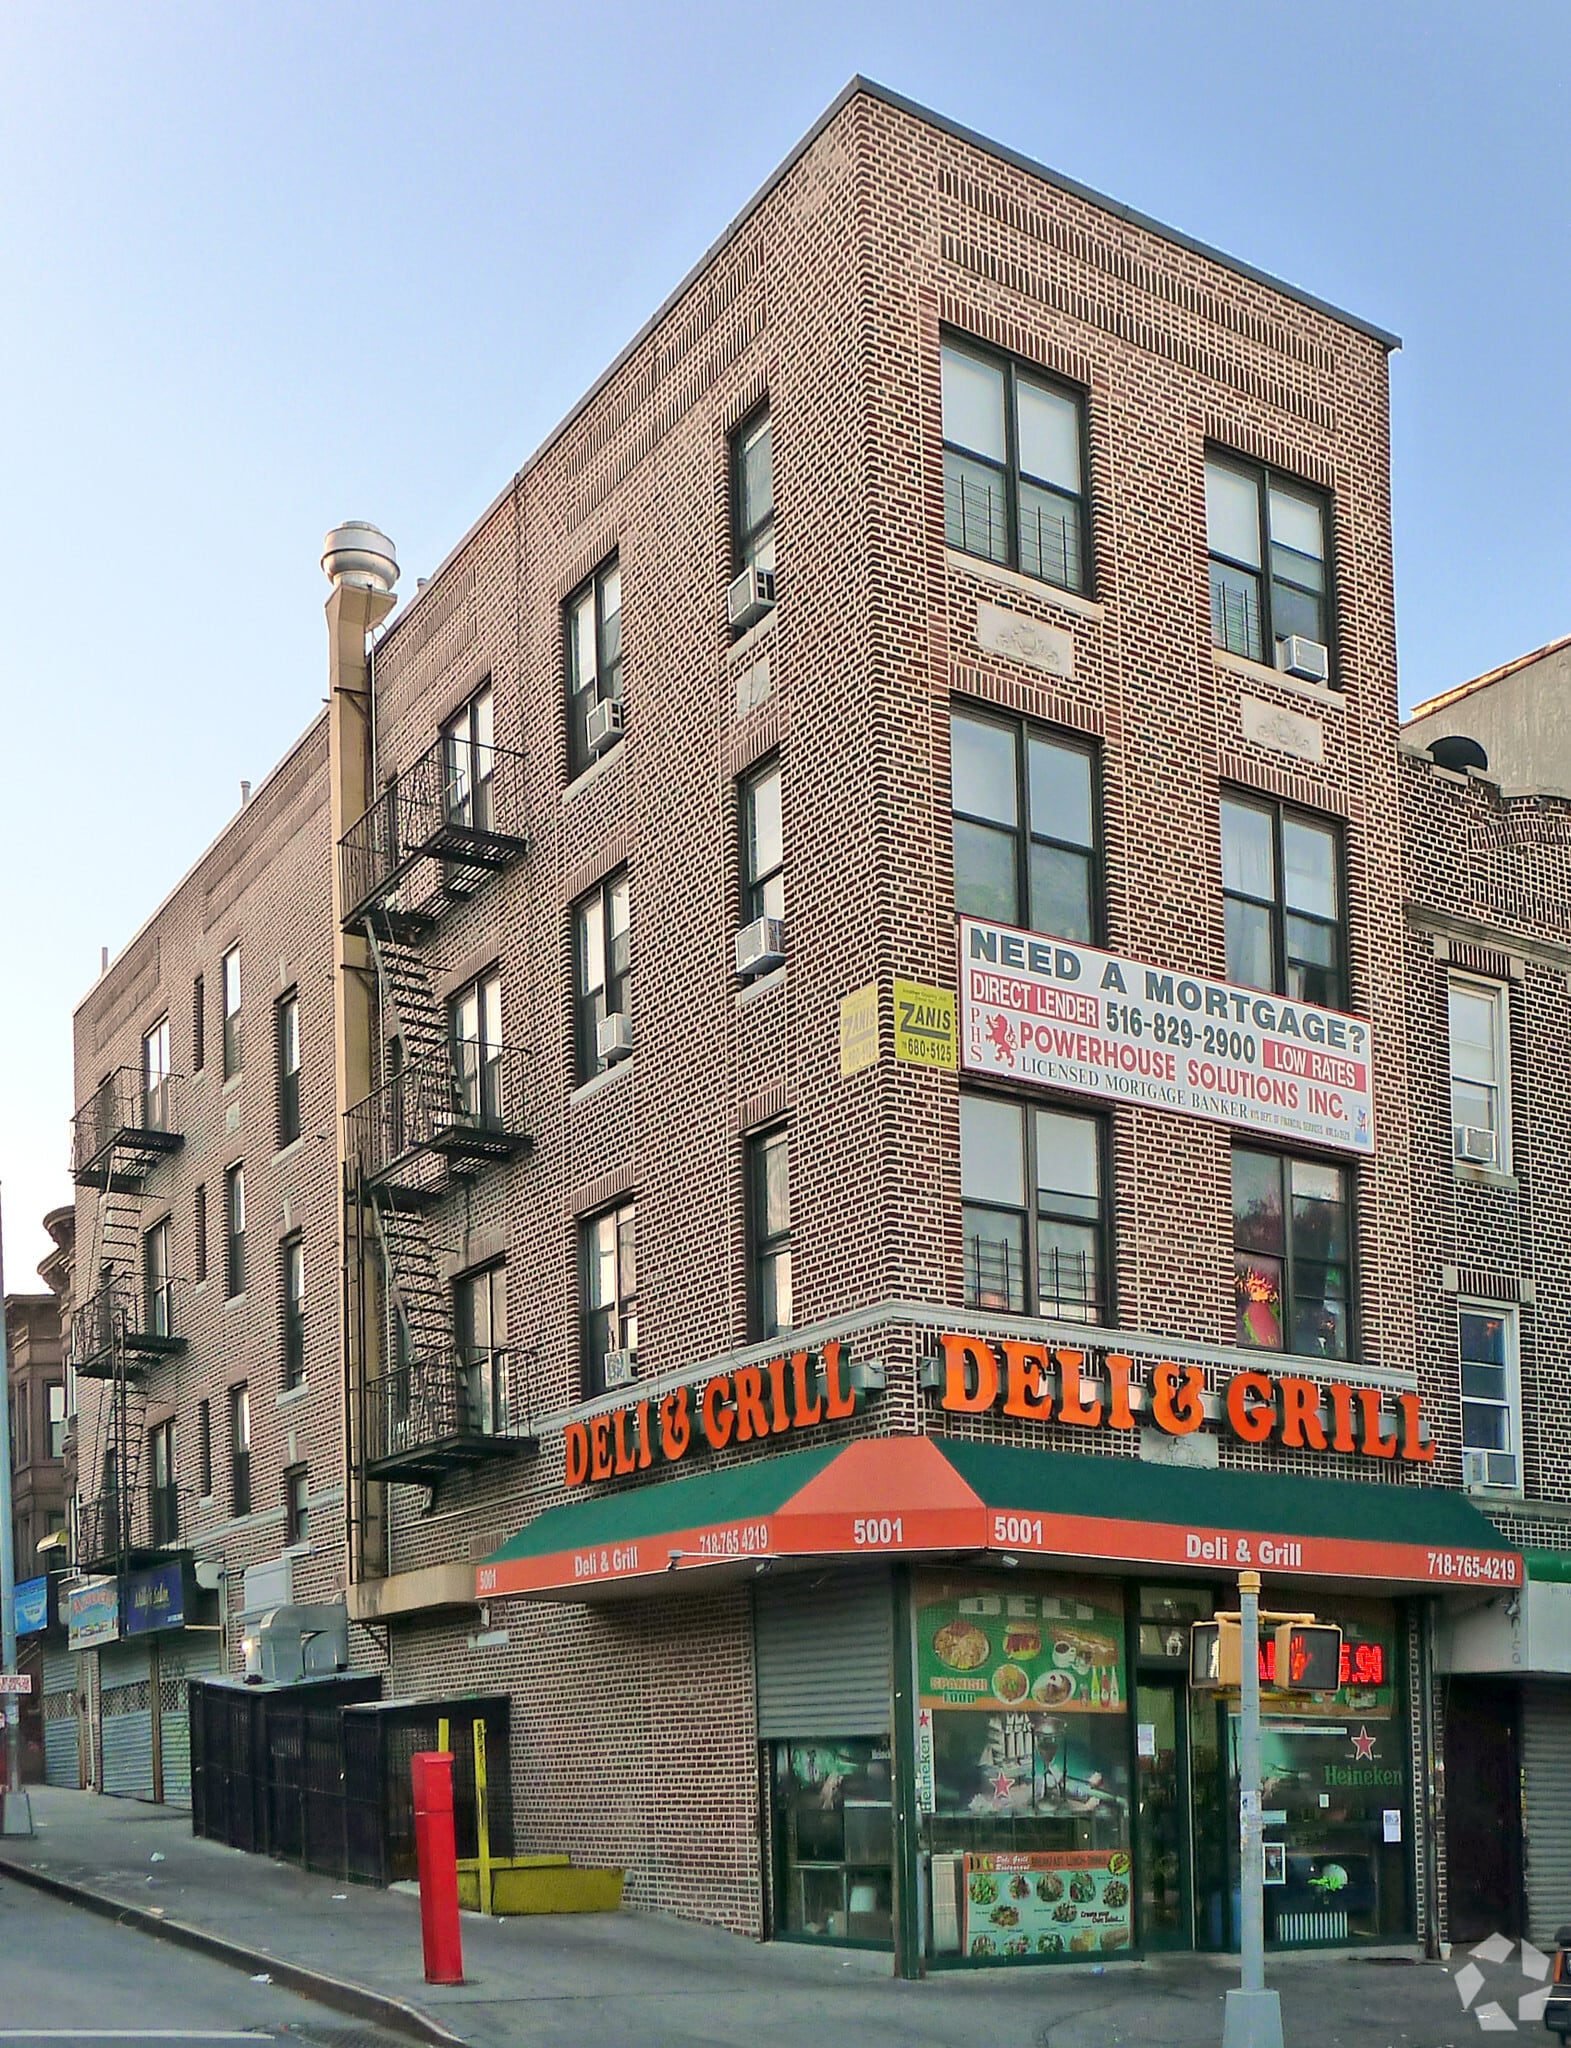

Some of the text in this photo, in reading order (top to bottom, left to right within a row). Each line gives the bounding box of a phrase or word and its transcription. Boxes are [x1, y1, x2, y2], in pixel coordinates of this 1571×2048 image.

[970, 928, 1366, 1054] NEED A MORTGAGE?
[973, 972, 1097, 1028] DIRECT LENDER
[899, 1001, 951, 1041] ZANIS
[1106, 1001, 1256, 1064] 516-829-2900
[1020, 1021, 1348, 1121] POWERHOUSE SOLUTIONS INC.
[1274, 1044, 1355, 1087] LOW RATES
[1022, 1056, 1248, 1119] LICENSED MORTGAGE BANKER
[564, 1342, 856, 1487] DELI & GRILL
[940, 1334, 1437, 1462] DELI & GRILL
[854, 1517, 902, 1544] 5001
[994, 1516, 1042, 1545] 5001
[574, 1546, 638, 1578] Deli & Grill
[1186, 1534, 1302, 1567] Deli & Grill
[1427, 1552, 1516, 1580] 718-765-4219
[480, 1569, 497, 1590] 5001
[958, 1596, 1094, 1620] DELI
[930, 1677, 988, 1691] SPANISH
[943, 1691, 976, 1704] FOOD
[921, 1735, 932, 1813] Heineken
[1325, 1765, 1402, 1786] Heineken
